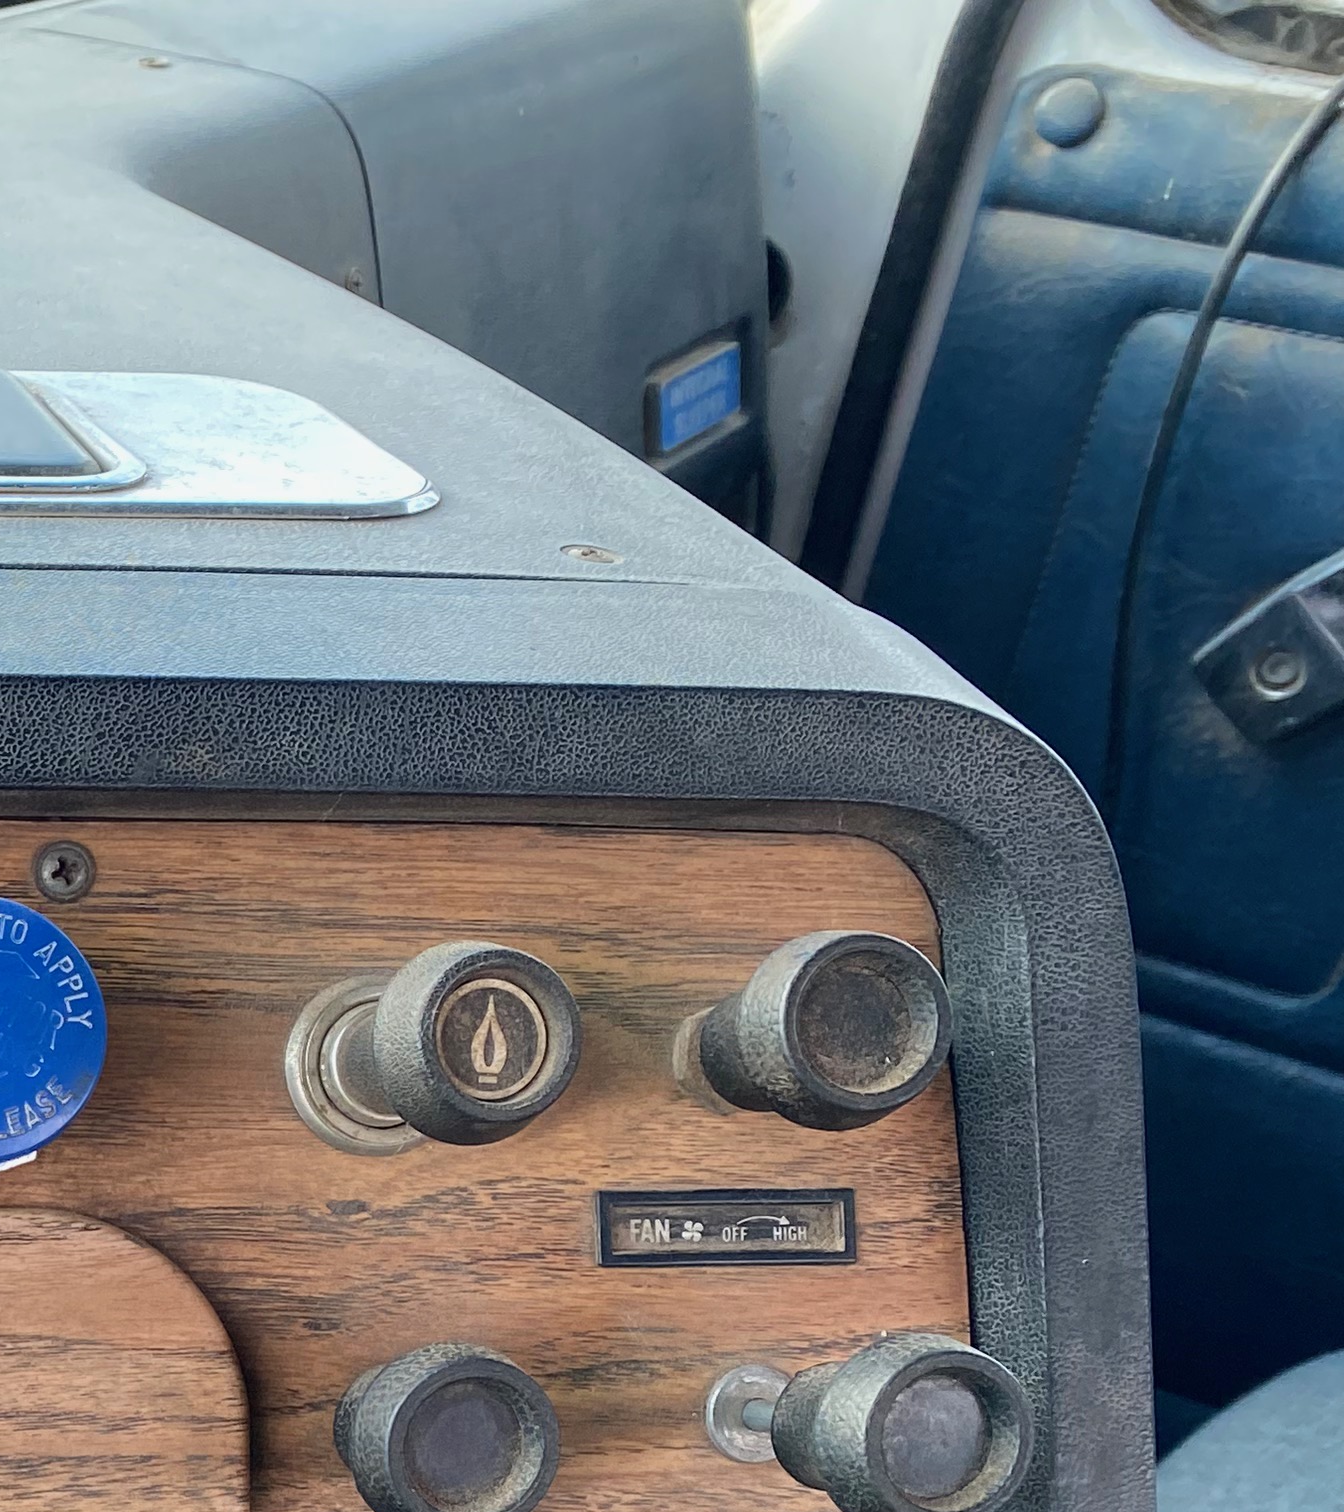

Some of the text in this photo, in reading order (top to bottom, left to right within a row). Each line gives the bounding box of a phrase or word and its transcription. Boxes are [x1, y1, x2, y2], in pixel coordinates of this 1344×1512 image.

[33, 940, 94, 1031] APPLY
[629, 1218, 808, 1243] FAN OFF HIGH
